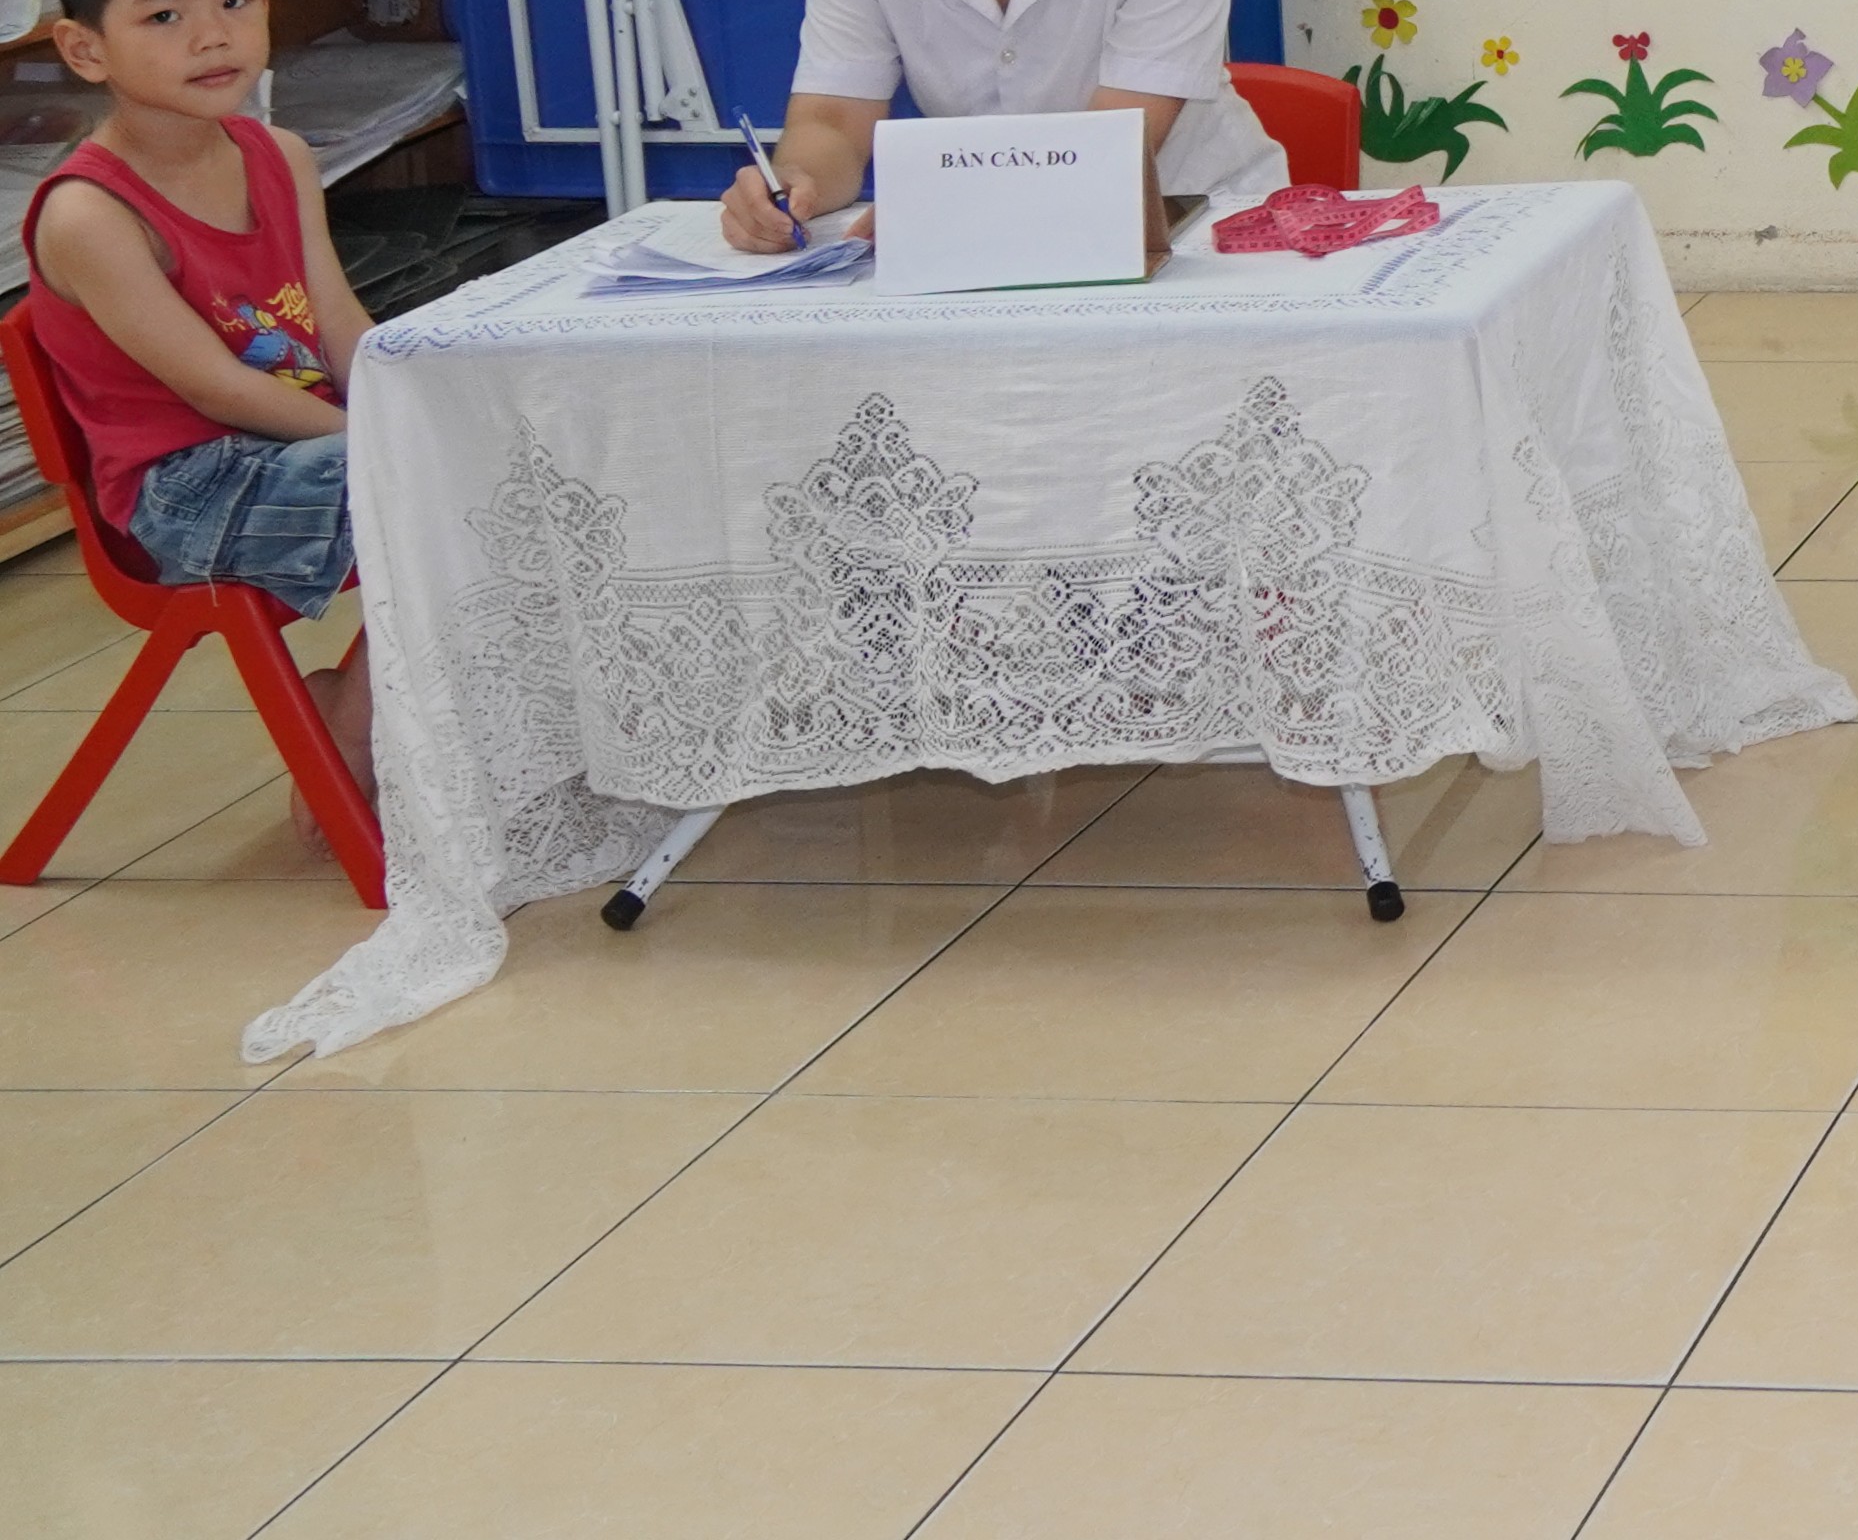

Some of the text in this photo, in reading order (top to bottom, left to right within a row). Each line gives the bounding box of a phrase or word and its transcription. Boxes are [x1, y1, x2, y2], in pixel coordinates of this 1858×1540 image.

[940, 146, 1077, 168] BÀN CÂN, ĐO
